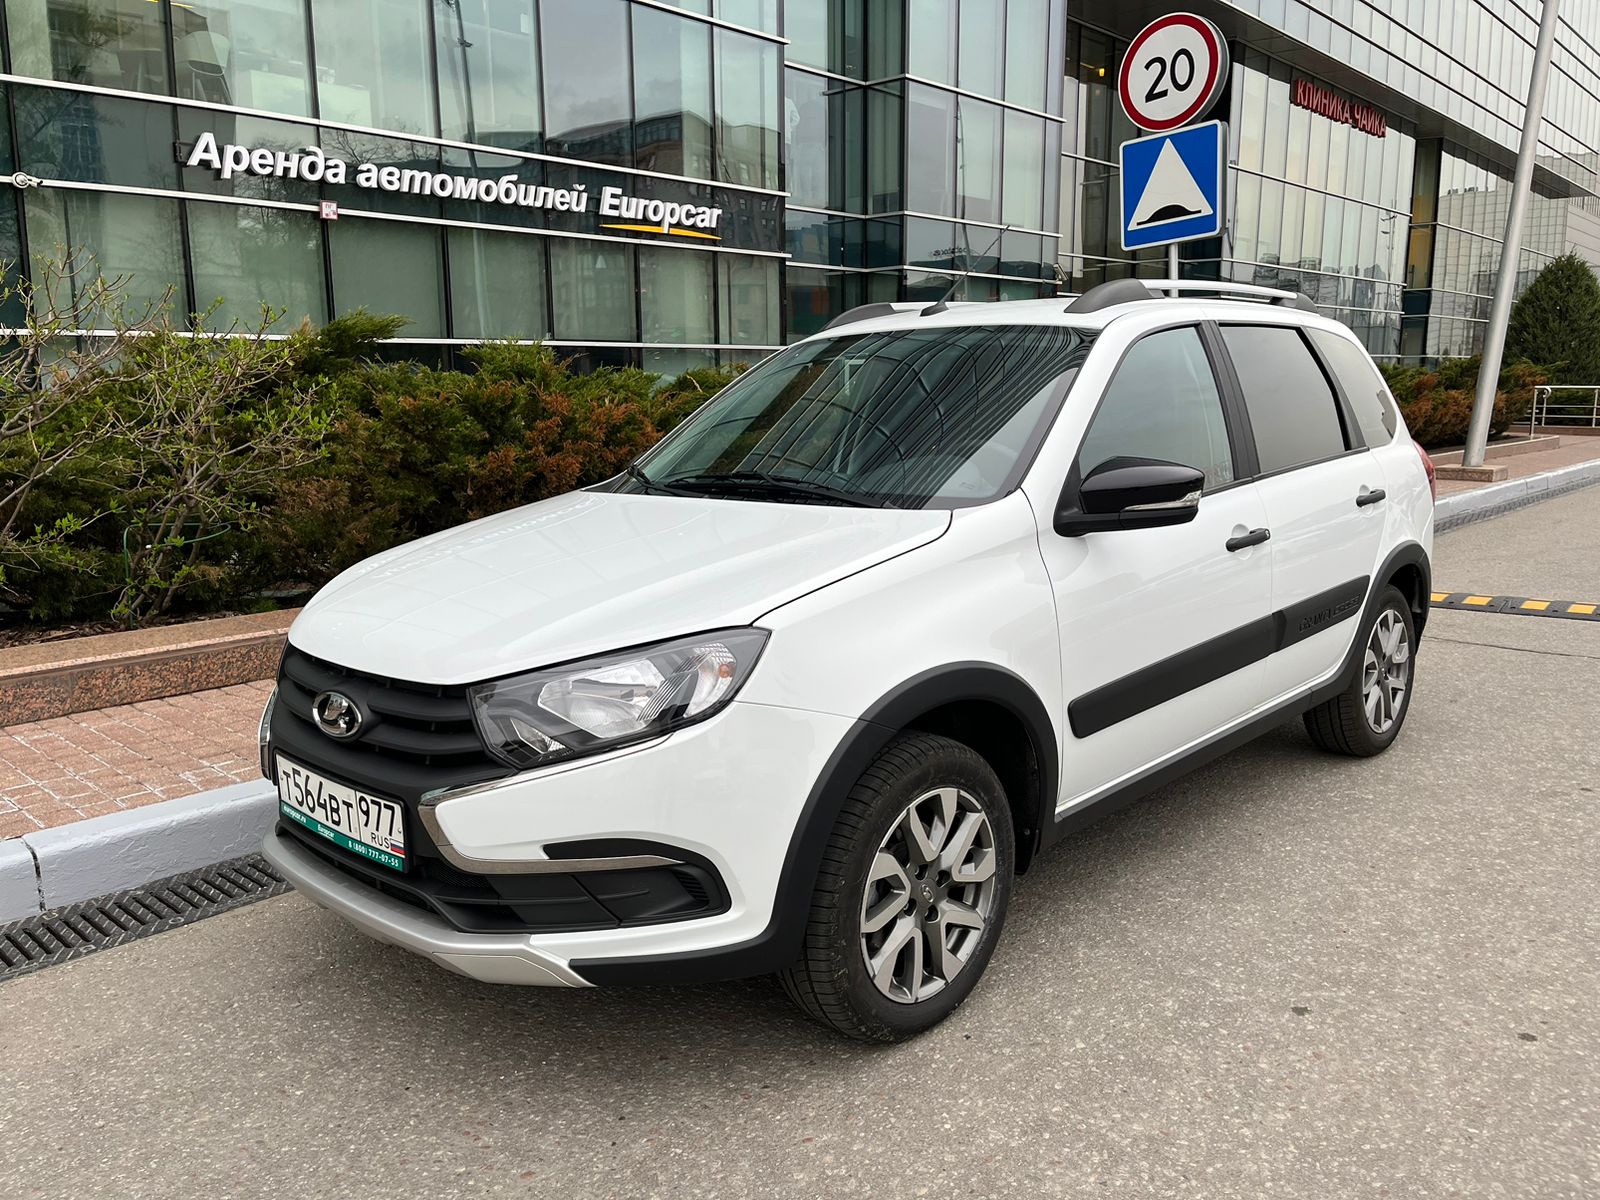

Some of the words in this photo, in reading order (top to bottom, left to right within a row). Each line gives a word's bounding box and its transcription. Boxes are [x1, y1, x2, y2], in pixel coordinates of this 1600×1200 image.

[1144, 48, 1195, 103] 20
[1354, 104, 1386, 136] ЧАЙКА
[187, 132, 346, 185] Аренда
[356, 162, 588, 212] автомобилей
[600, 186, 722, 234] Europcar
[359, 796, 396, 836] 977
[371, 832, 390, 849] RUS
